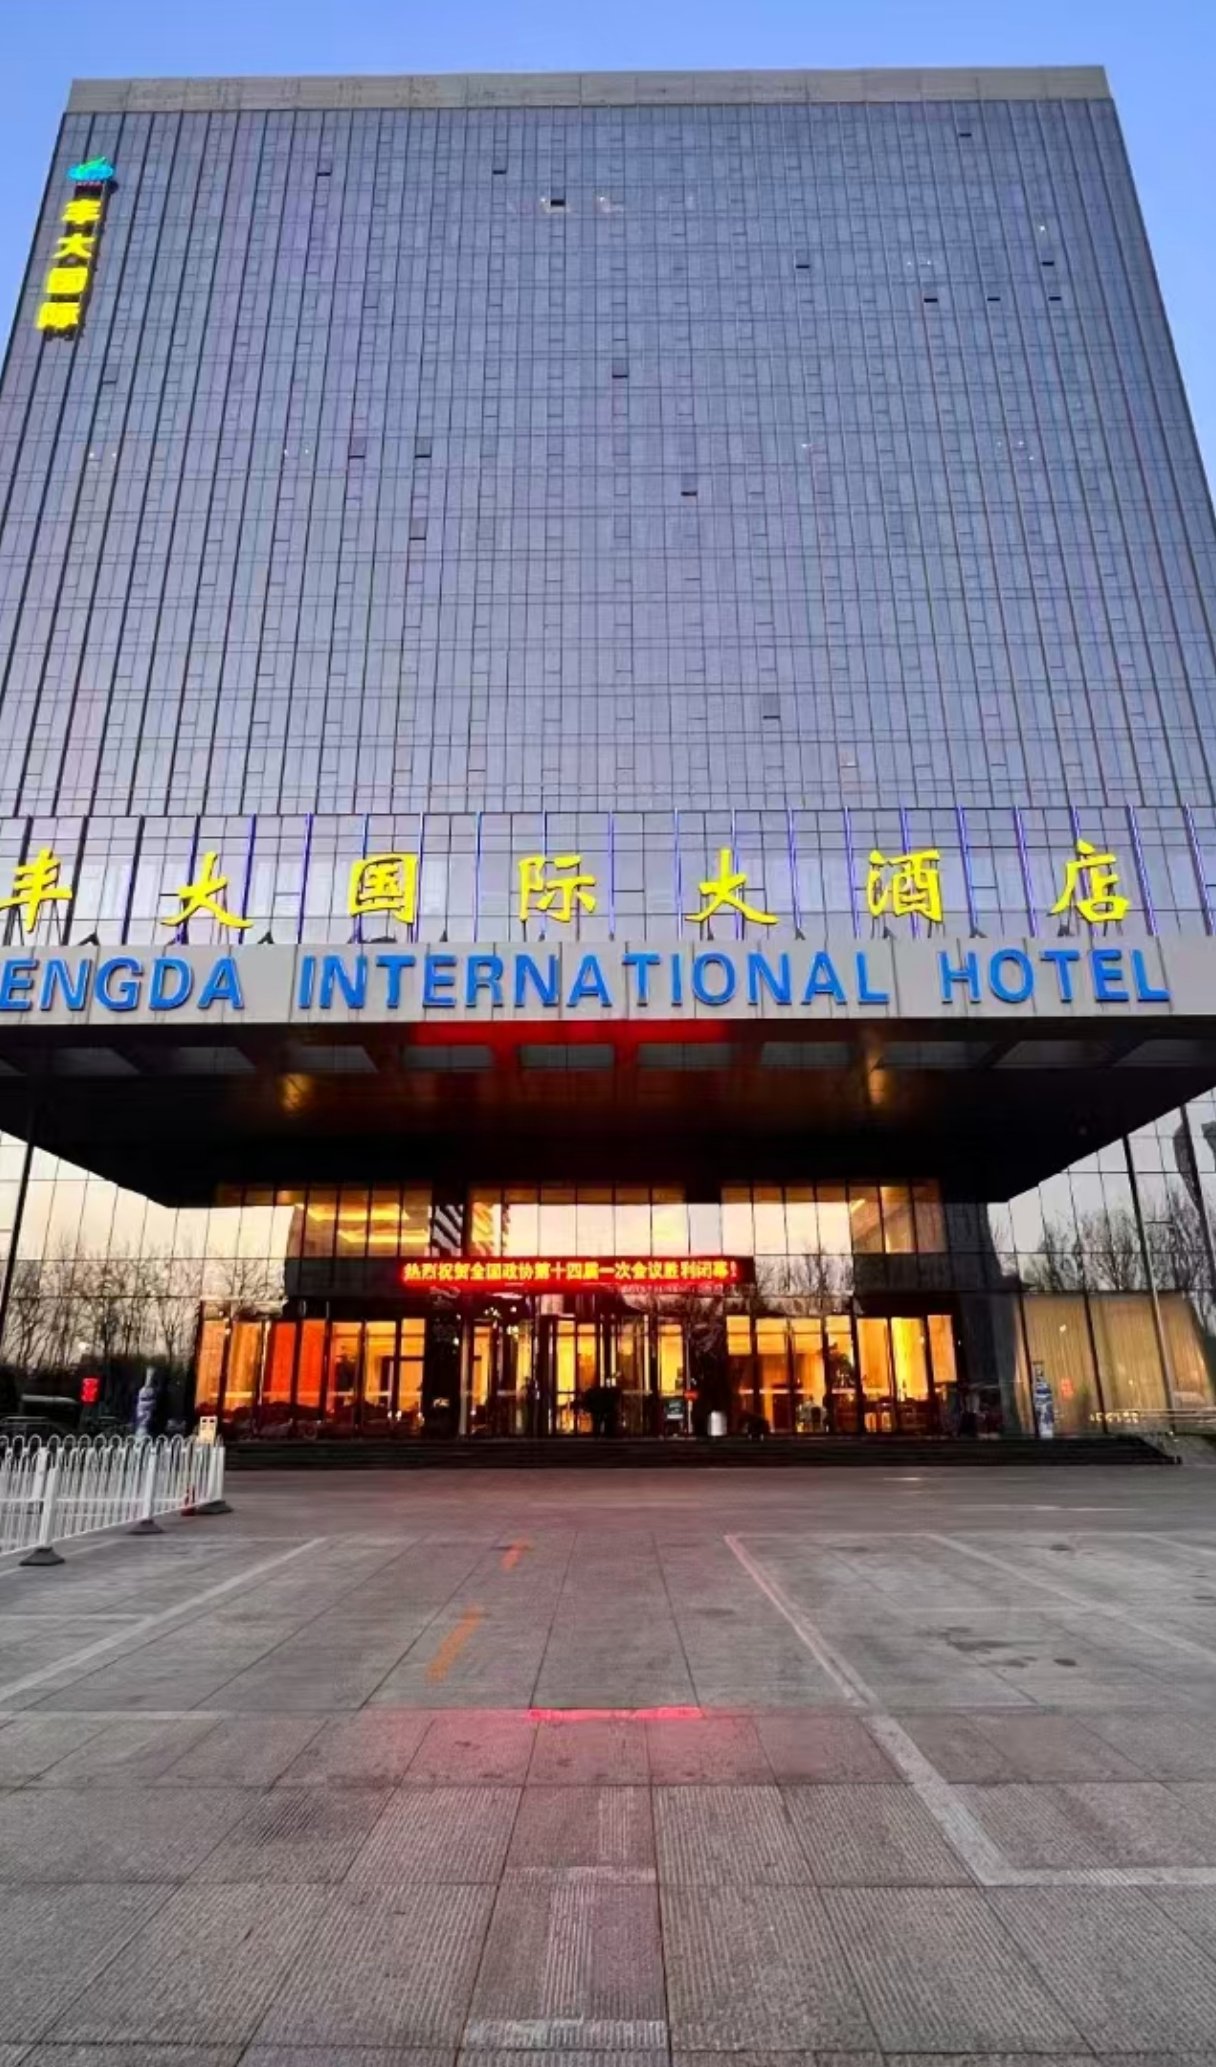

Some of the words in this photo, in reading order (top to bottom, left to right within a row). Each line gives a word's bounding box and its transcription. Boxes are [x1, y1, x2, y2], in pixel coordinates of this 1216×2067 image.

[0, 841, 1131, 930] 丰大国际大酒店
[297, 951, 889, 1008] INTERNATIONAL
[938, 948, 1171, 1004] HOTEL
